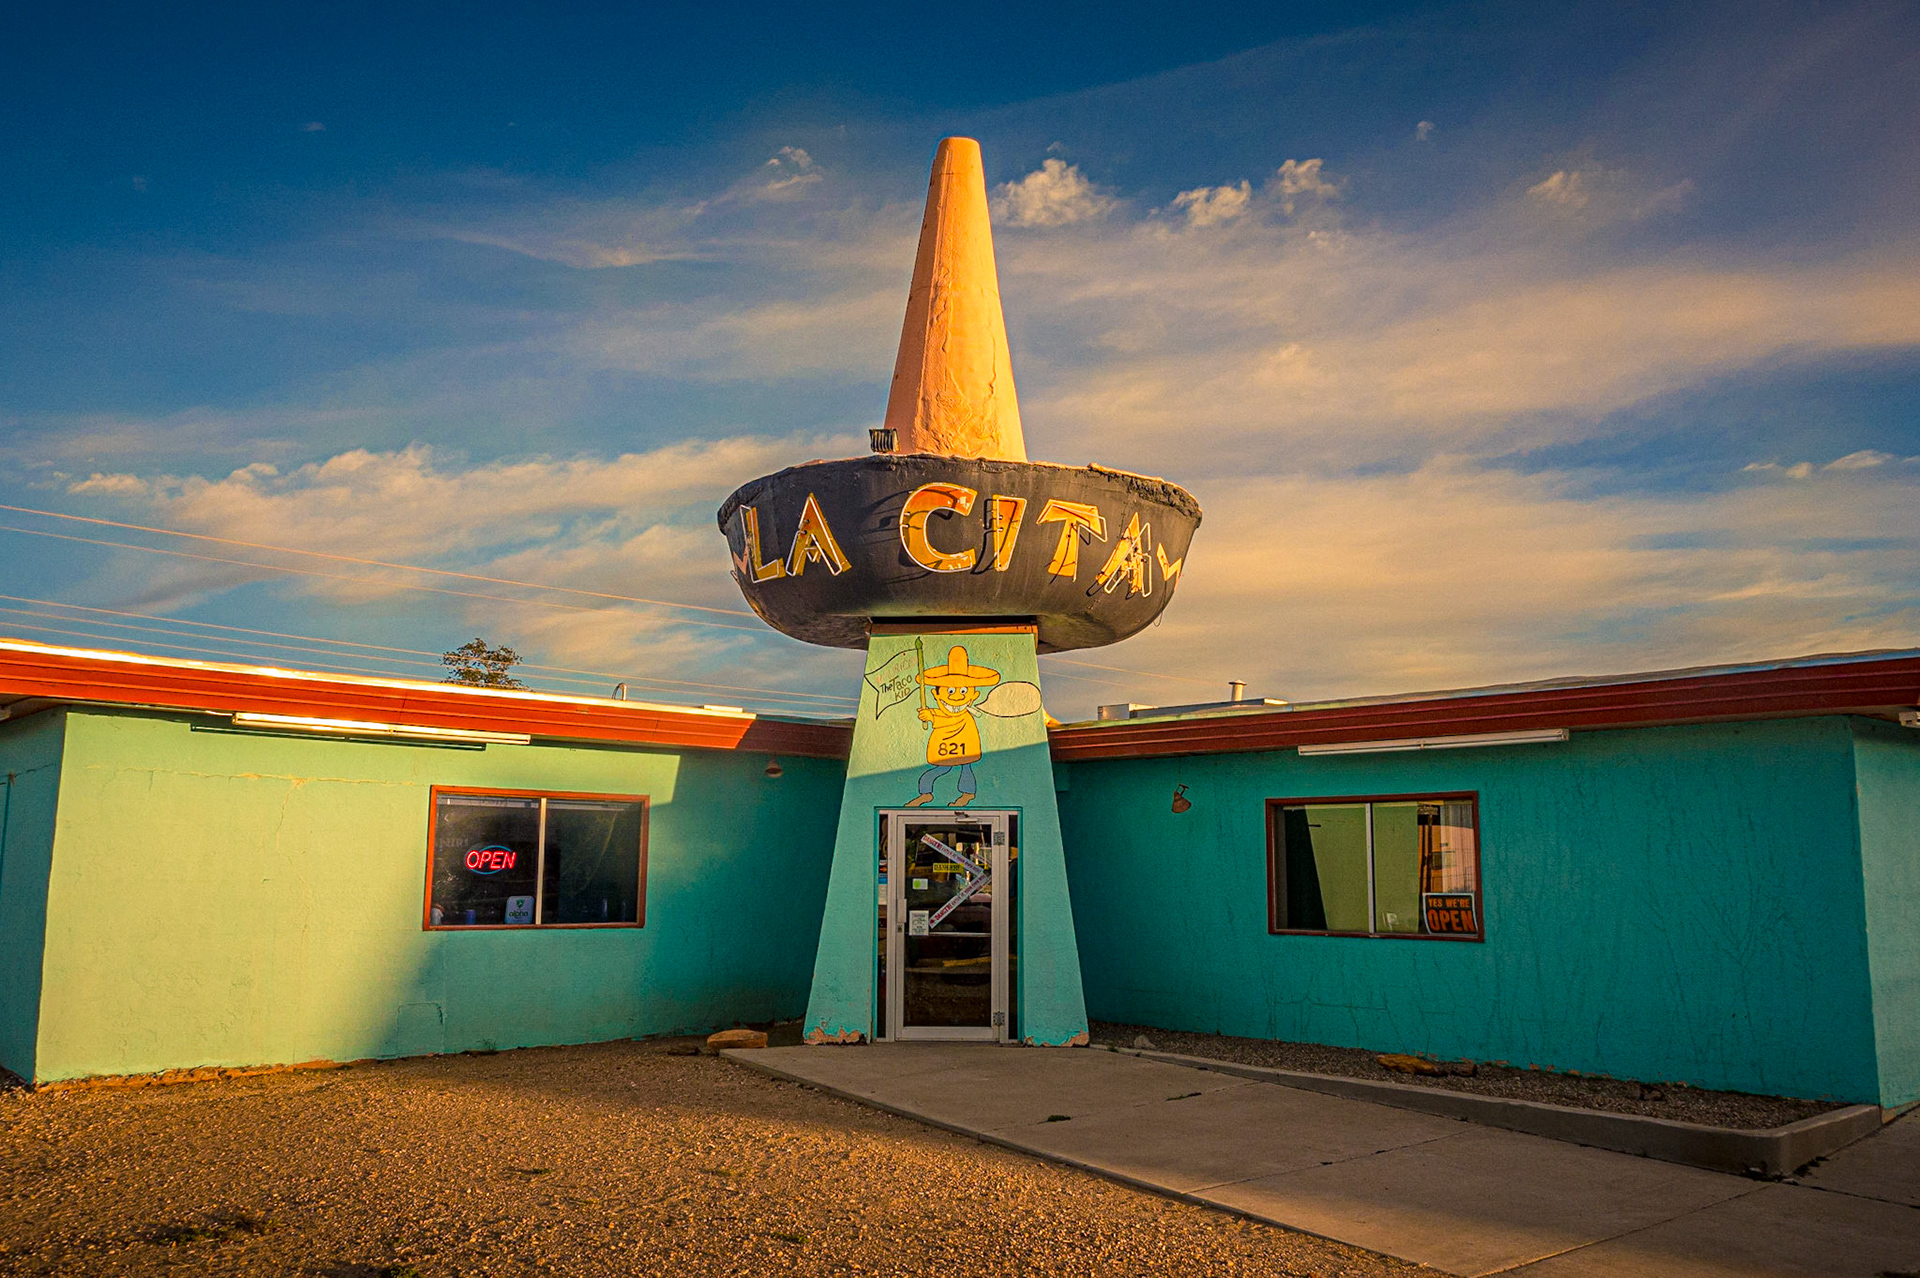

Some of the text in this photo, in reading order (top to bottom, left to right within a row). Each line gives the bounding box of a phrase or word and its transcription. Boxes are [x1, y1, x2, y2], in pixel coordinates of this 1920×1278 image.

[739, 481, 1152, 598] LA CITA
[889, 675, 913, 693] Taco
[894, 687, 911, 701] KID
[938, 742, 966, 757] 821
[465, 849, 517, 870] OPEN
[1428, 898, 1470, 908] YES WE'RE
[1427, 909, 1476, 932] OPEN
